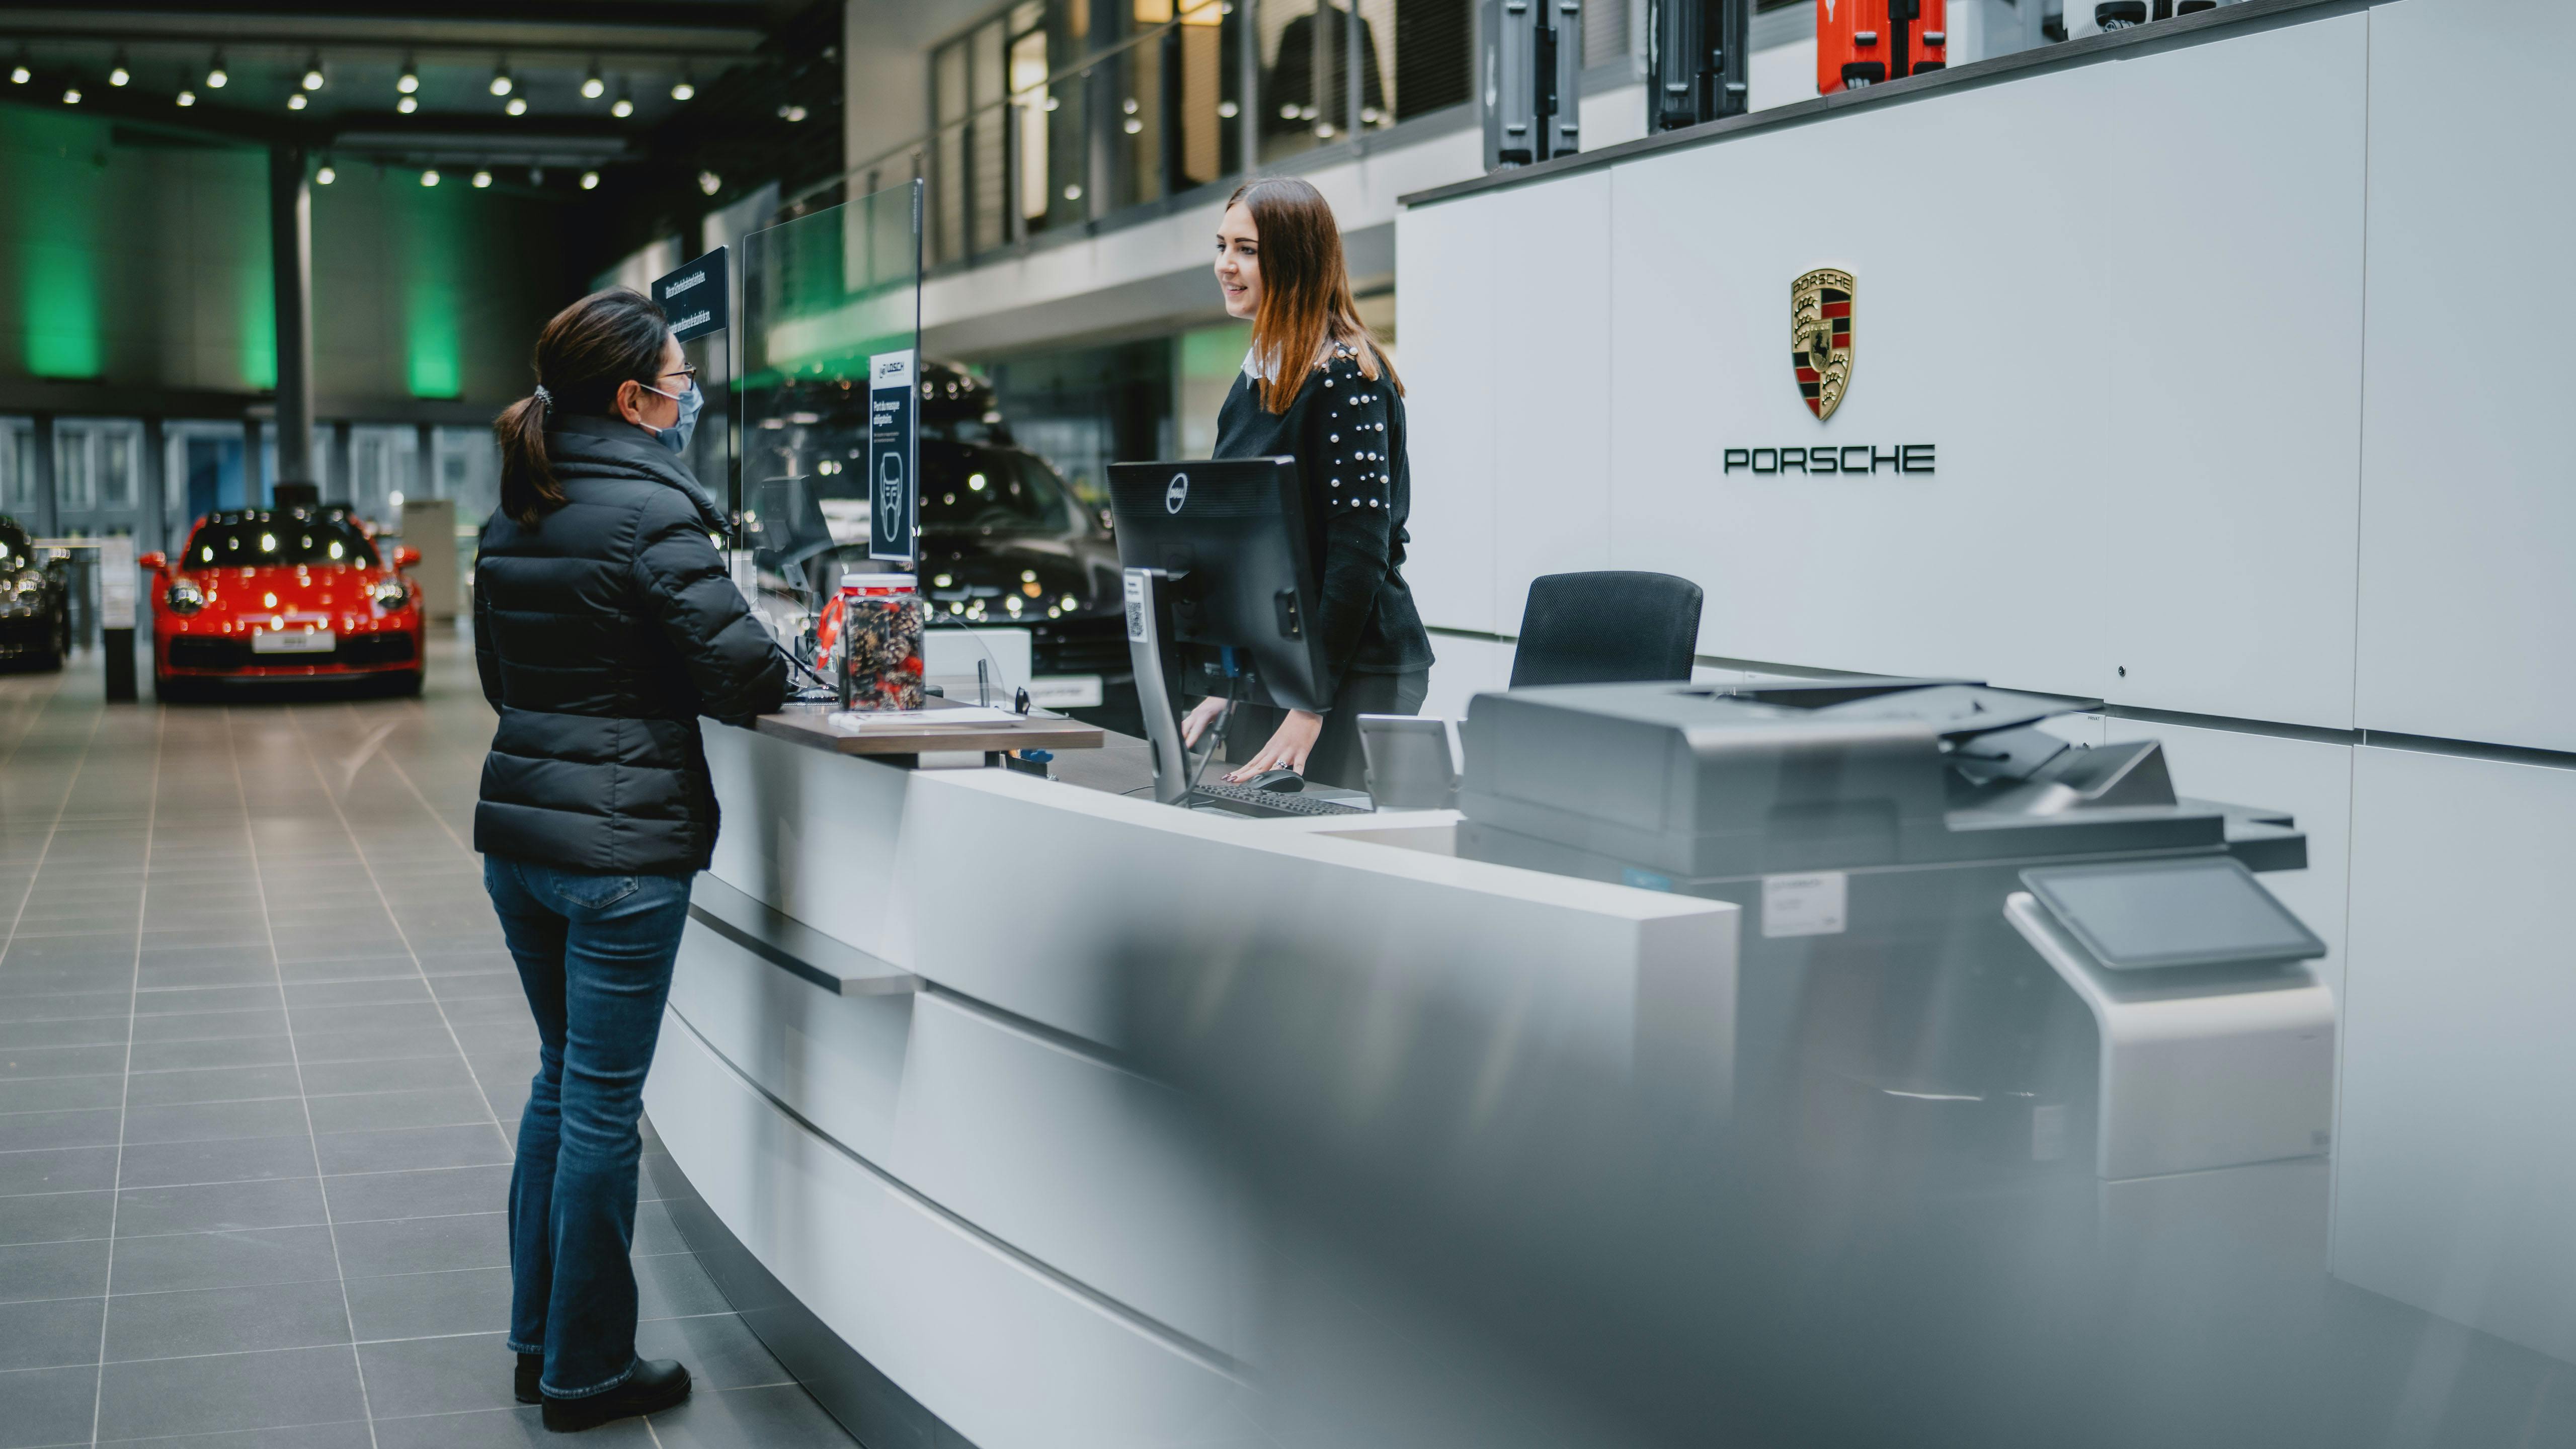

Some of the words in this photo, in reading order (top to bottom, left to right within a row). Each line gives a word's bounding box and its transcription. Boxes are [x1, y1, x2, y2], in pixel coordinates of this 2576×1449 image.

[1793, 274, 1851, 296] PORSCHE
[887, 361, 904, 373] LOSCH
[885, 401, 900, 412] masque
[873, 414, 893, 427] obligatoire.
[1724, 444, 1936, 474] PORSCHE
